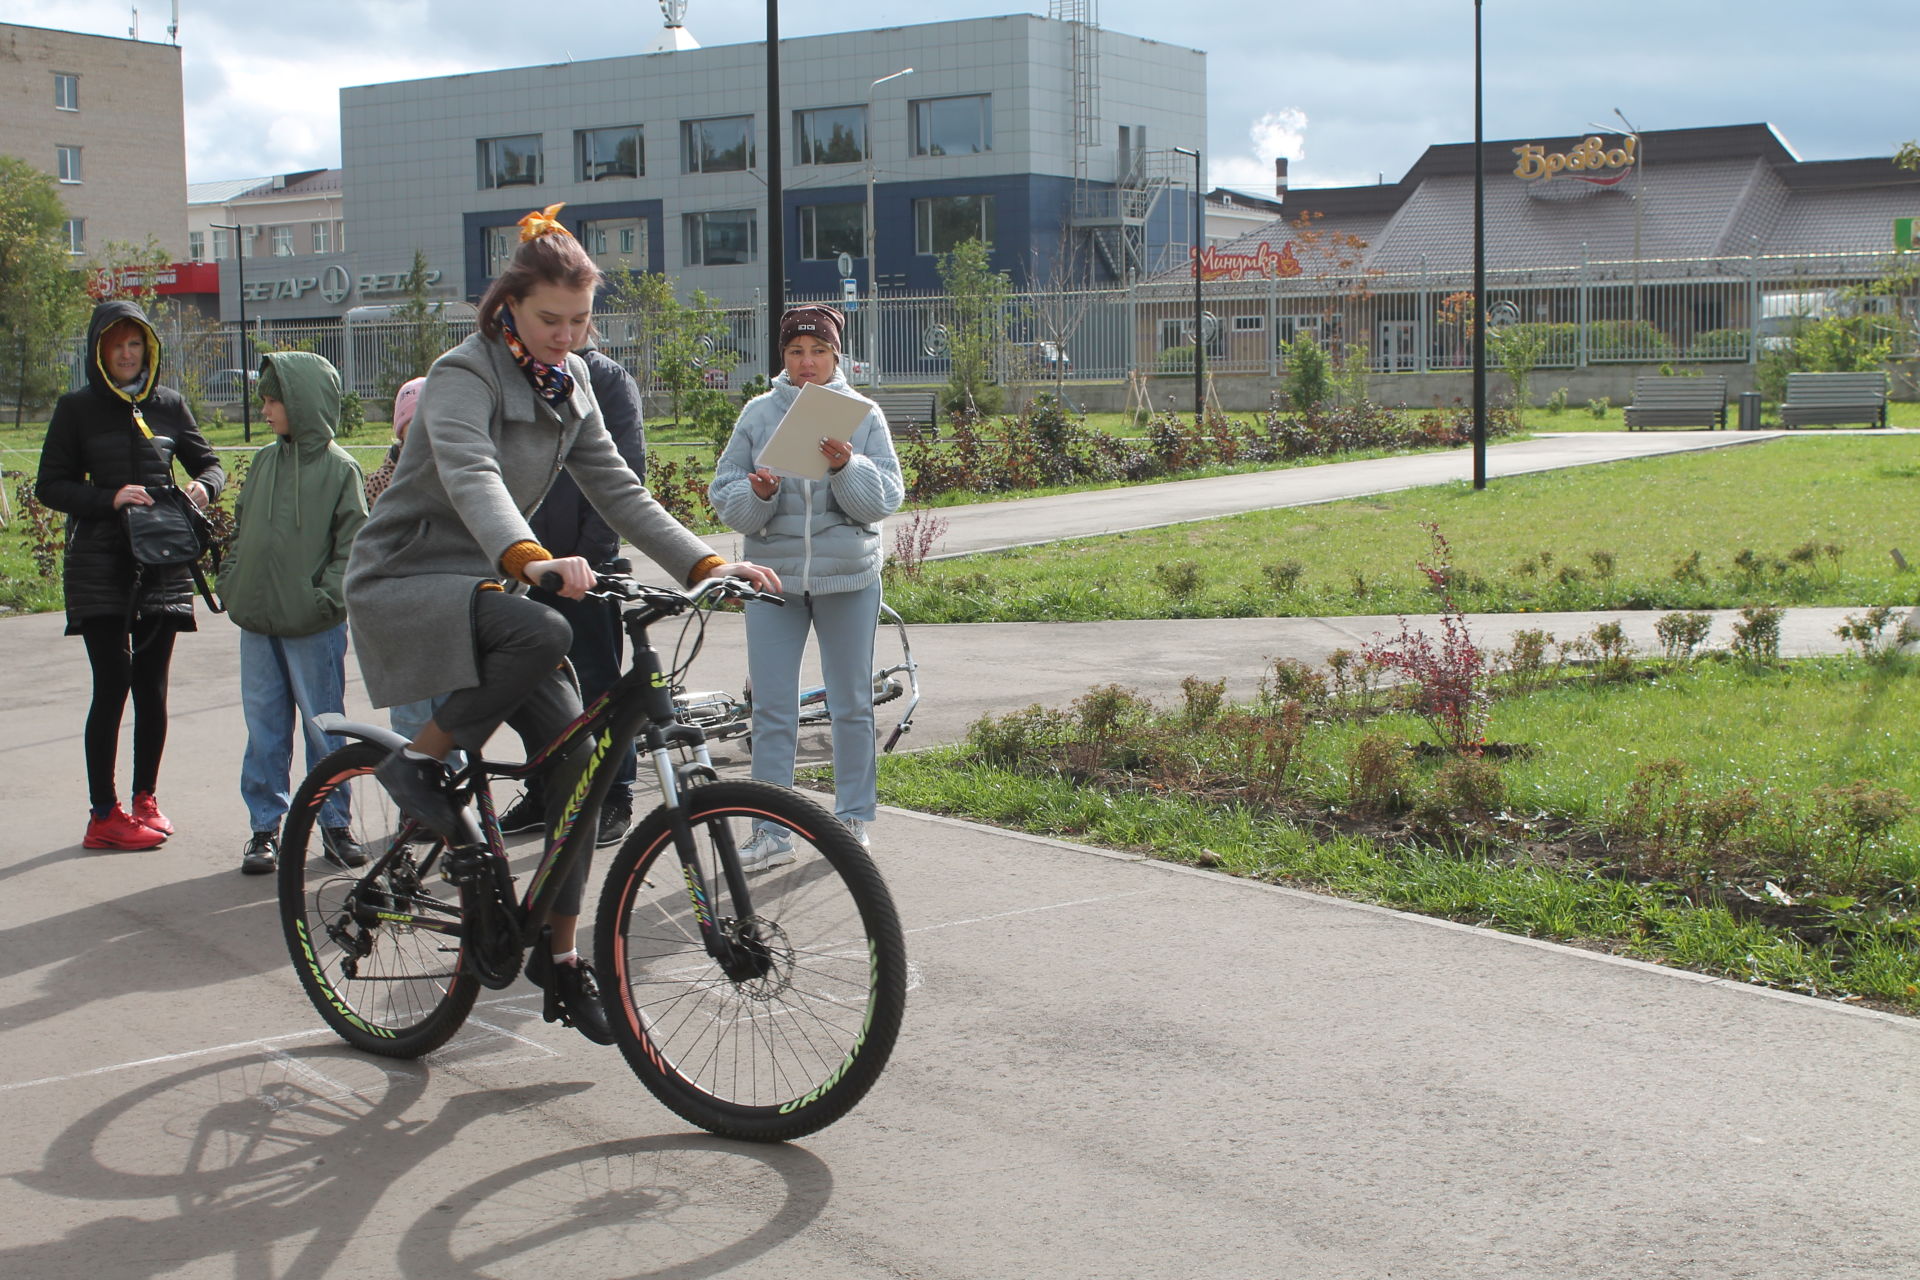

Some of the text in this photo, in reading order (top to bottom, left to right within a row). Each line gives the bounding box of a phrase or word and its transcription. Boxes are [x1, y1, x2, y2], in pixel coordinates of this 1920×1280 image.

[1512, 136, 1636, 181] Браво!
[553, 727, 613, 841] URMAN
[377, 911, 414, 923] URMAN
[296, 919, 351, 1015] URMAN
[779, 1025, 866, 1114] URMAN
